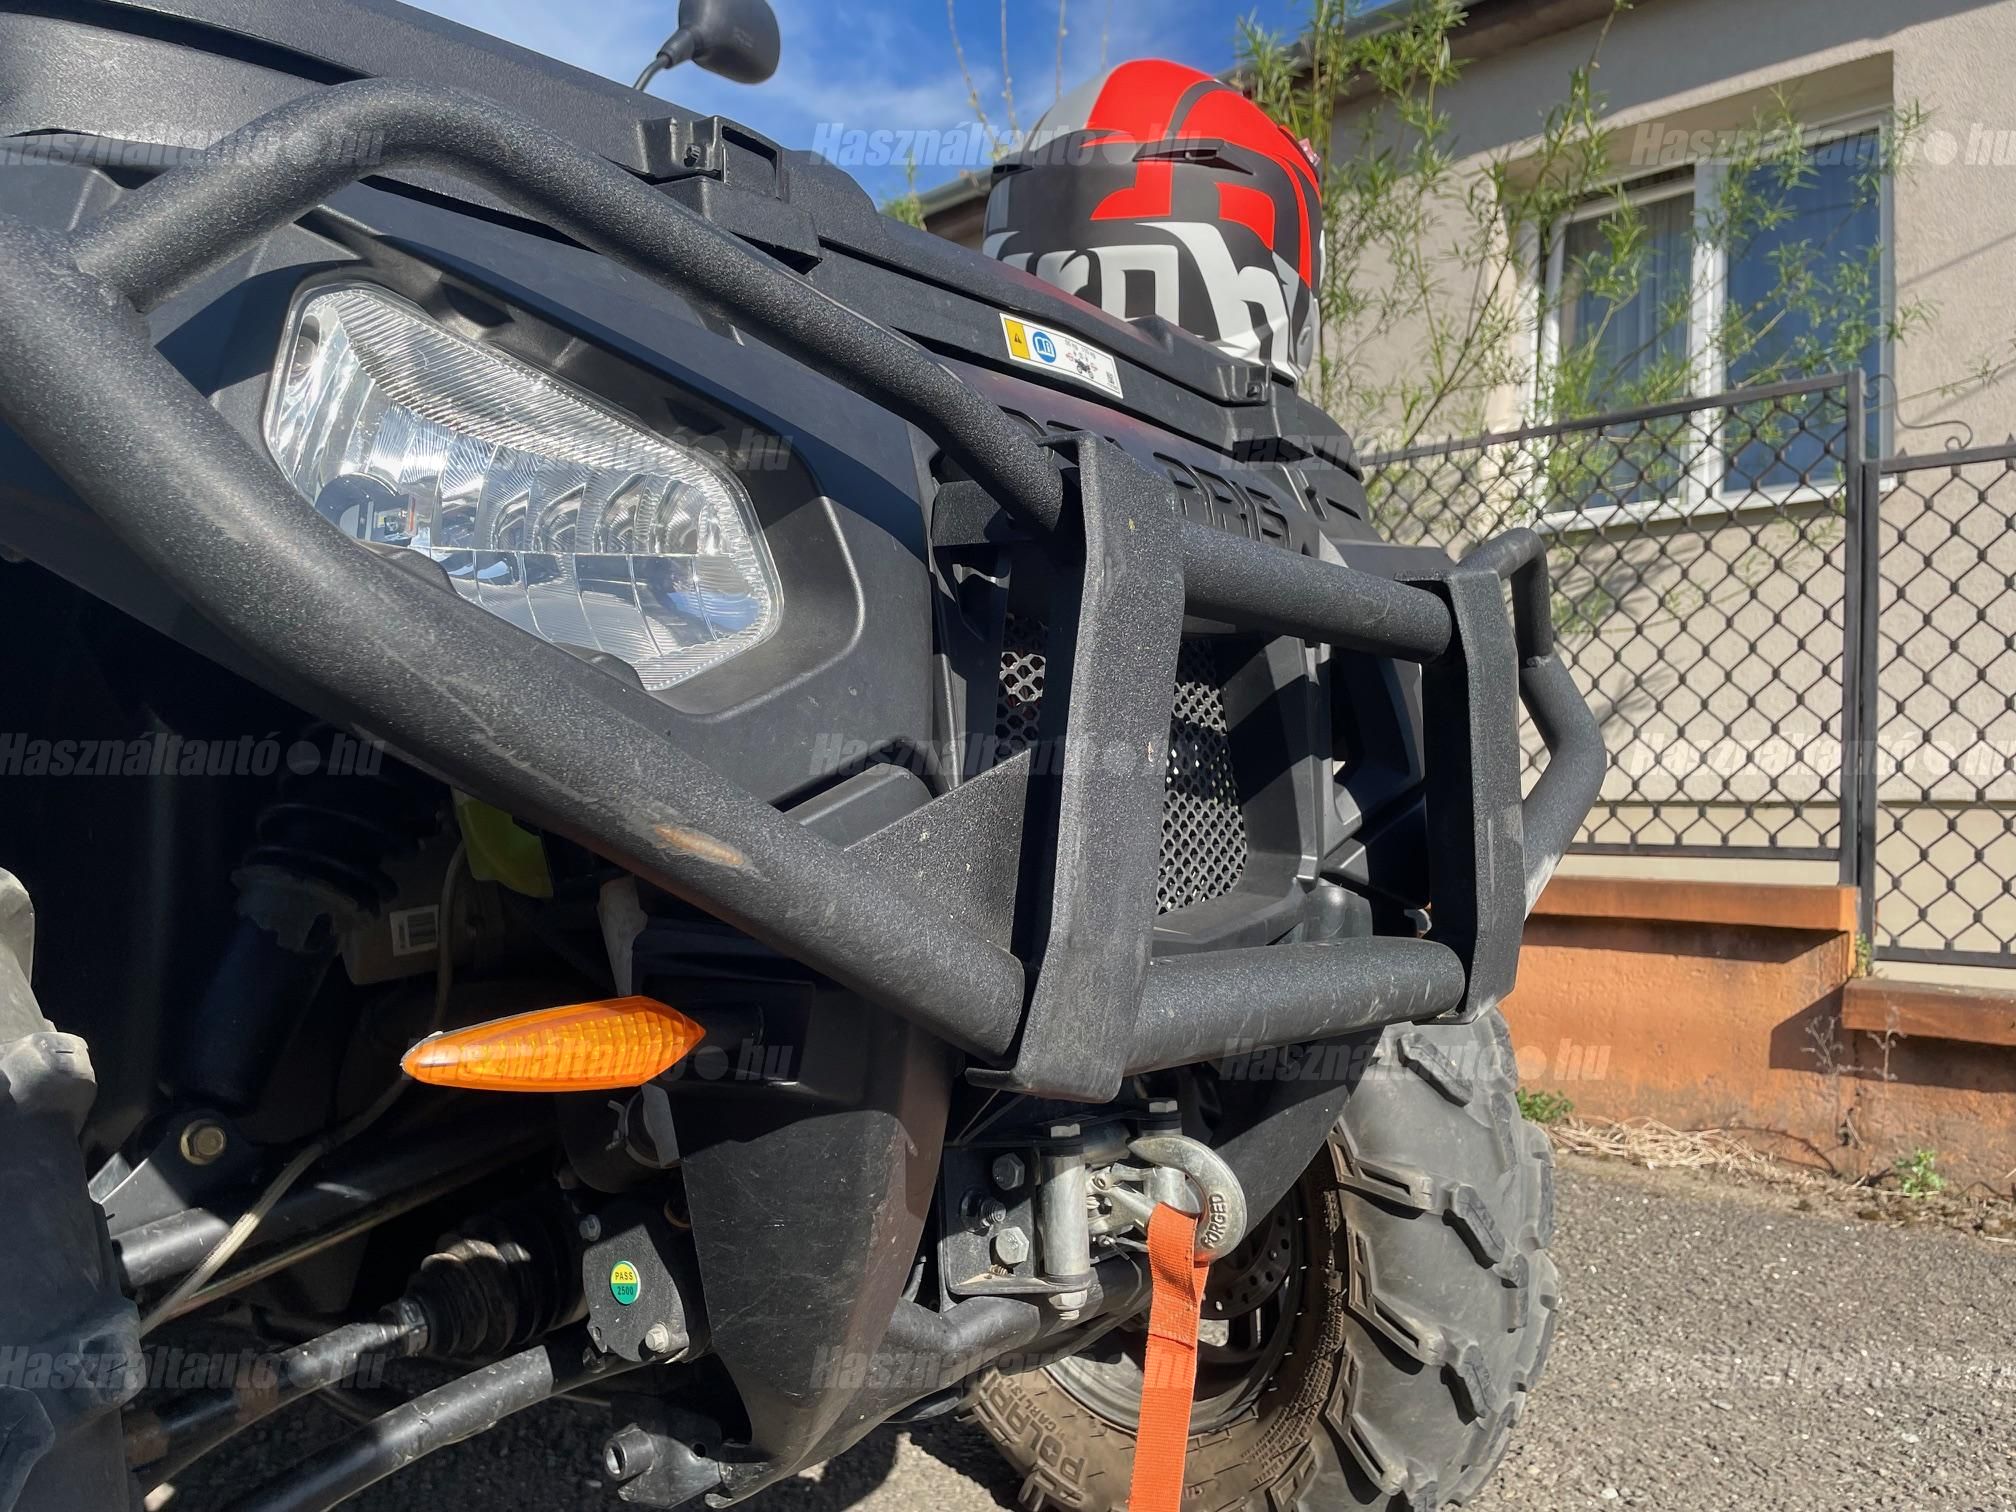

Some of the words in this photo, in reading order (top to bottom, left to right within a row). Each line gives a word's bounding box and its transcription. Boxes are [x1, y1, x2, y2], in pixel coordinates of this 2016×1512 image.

[1200, 1192, 1228, 1249] FORGED
[614, 1271, 634, 1281] PASS
[616, 1285, 634, 1296] 2500
[980, 1366, 1086, 1485] POLARI
[1005, 1375, 1057, 1433] CARLISL
